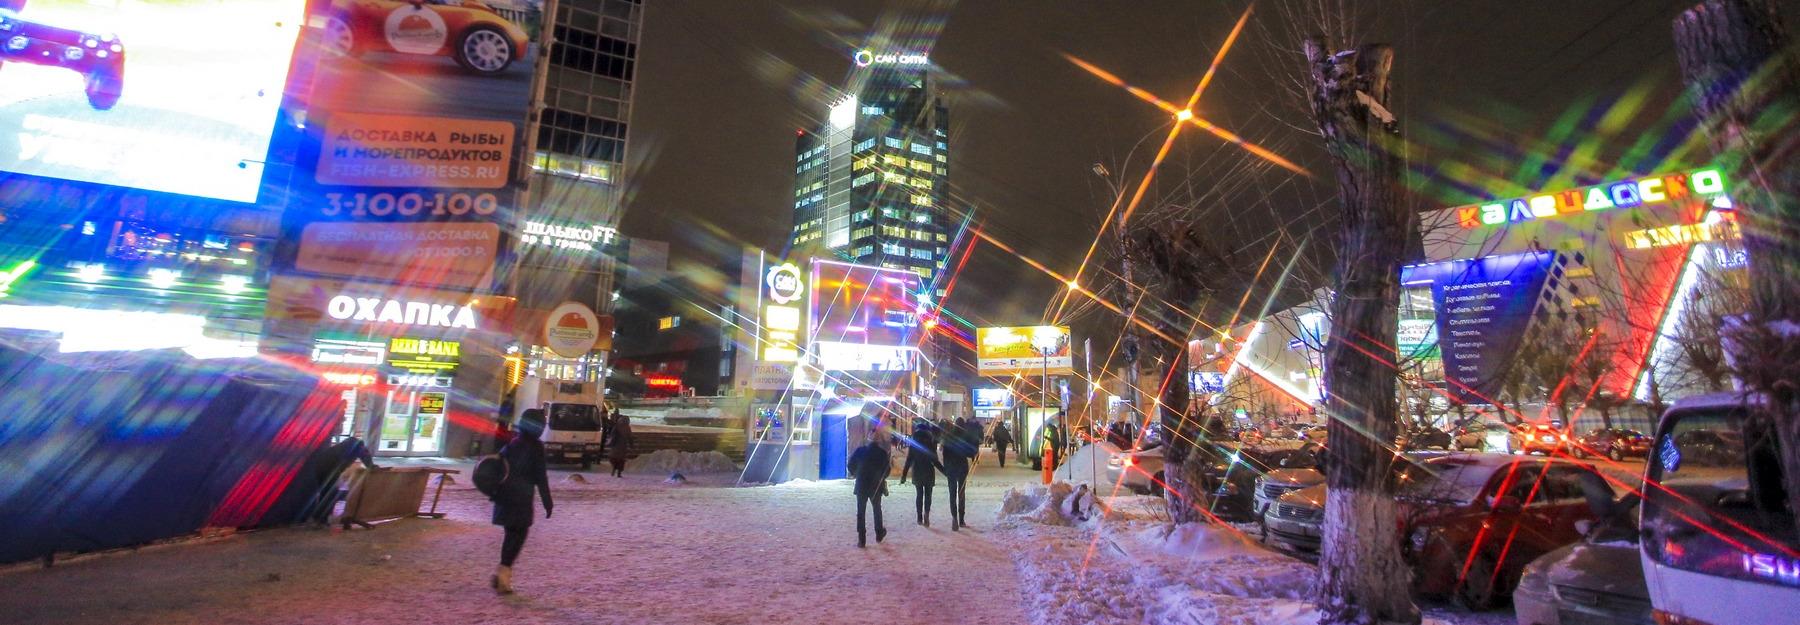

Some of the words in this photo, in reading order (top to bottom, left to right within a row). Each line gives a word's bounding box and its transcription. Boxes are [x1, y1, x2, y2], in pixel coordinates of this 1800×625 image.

[335, 129, 438, 143] ДОСТАВКА
[449, 132, 504, 145] РЫБЫ
[334, 147, 347, 158] И
[352, 147, 502, 162] МОРЕПРОДУКТОВ
[331, 164, 500, 179] FISH-EXPRESS.RU
[321, 192, 498, 216] 3-100-100
[415, 230, 490, 241] ДОСТАВКА
[328, 295, 476, 329] ОХАПКА
